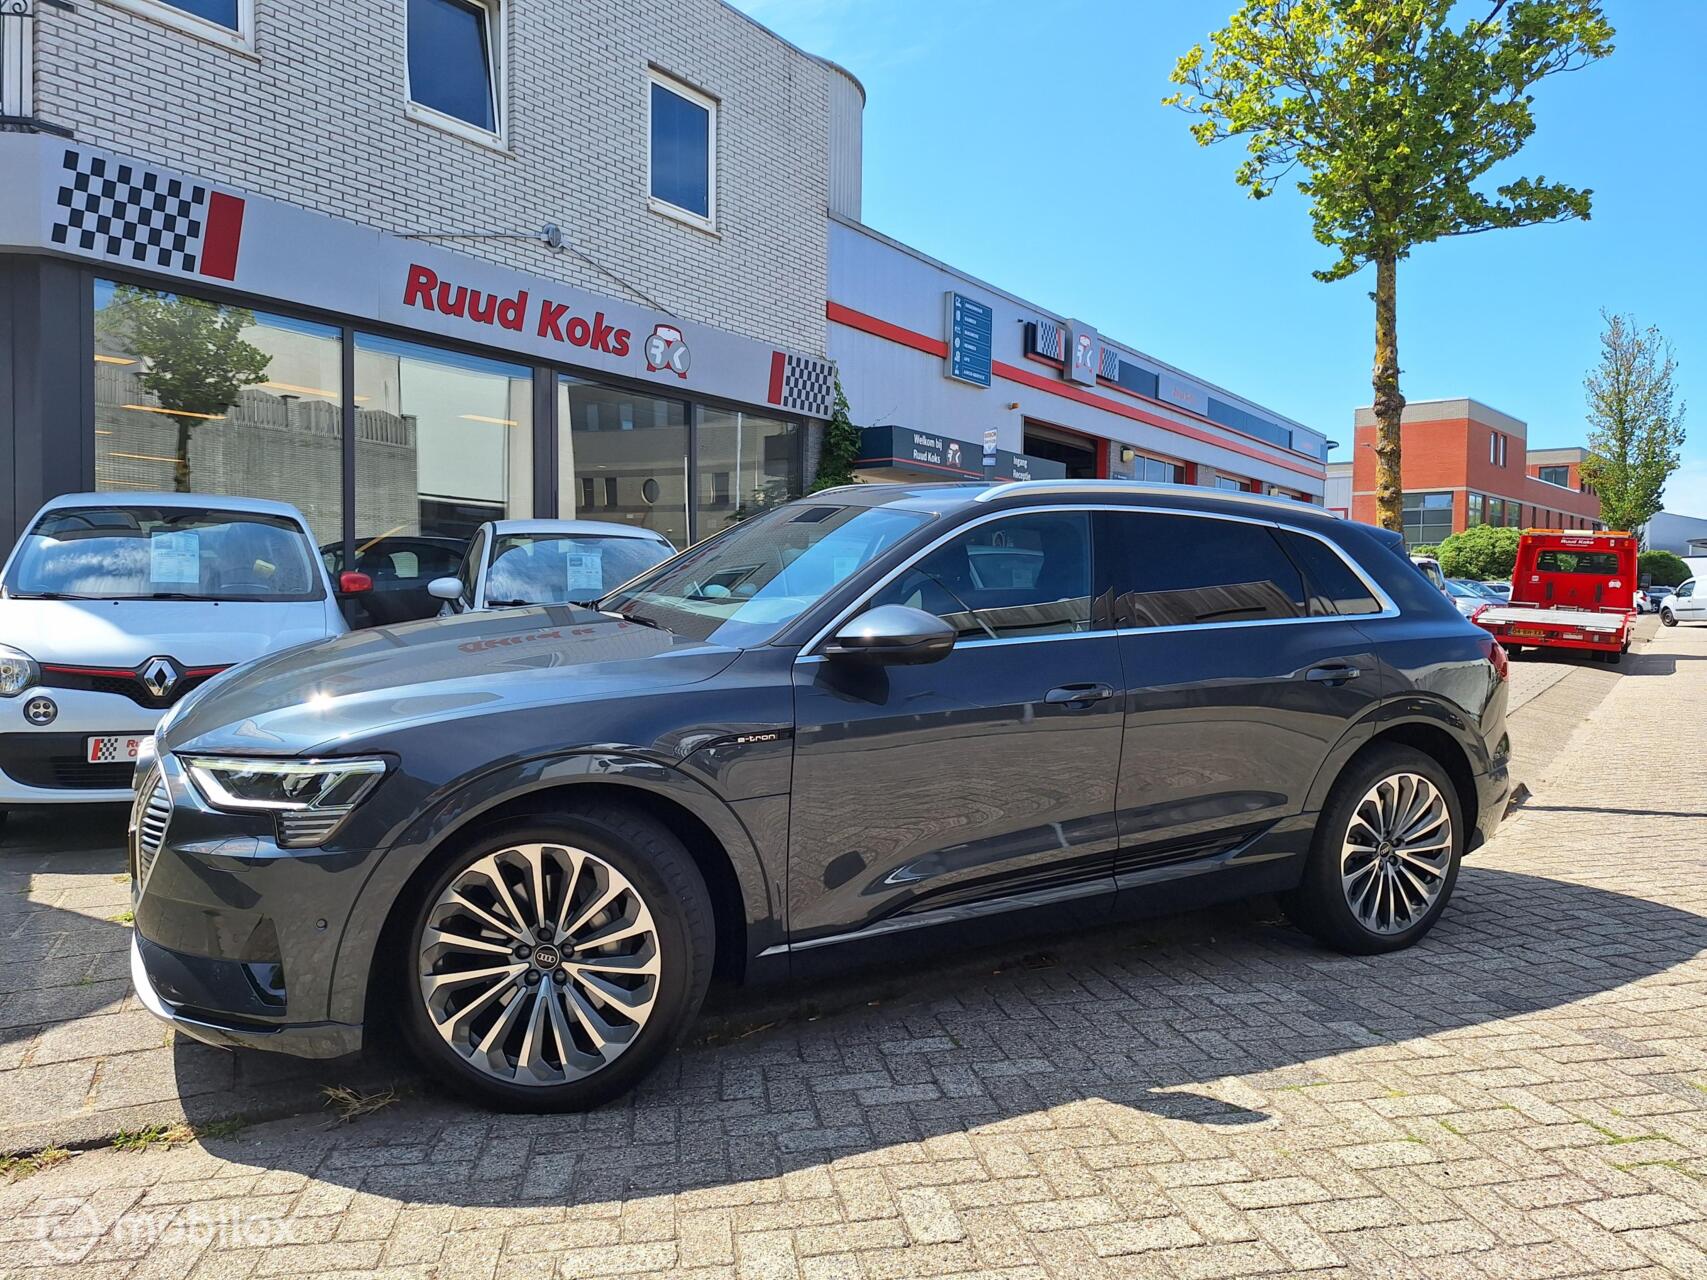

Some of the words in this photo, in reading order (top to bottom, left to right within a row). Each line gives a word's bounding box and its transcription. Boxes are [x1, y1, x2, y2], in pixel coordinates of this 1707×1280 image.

[403, 264, 528, 331] Ruud
[537, 299, 631, 357] Koks
[914, 434, 935, 448] Welkom
[935, 437, 943, 451] bij
[913, 449, 927, 461] Ruud
[927, 451, 941, 464] Koks
[1013, 456, 1028, 469] Ingang
[1013, 469, 1031, 481] Receptie
[737, 734, 776, 743] e-tron
